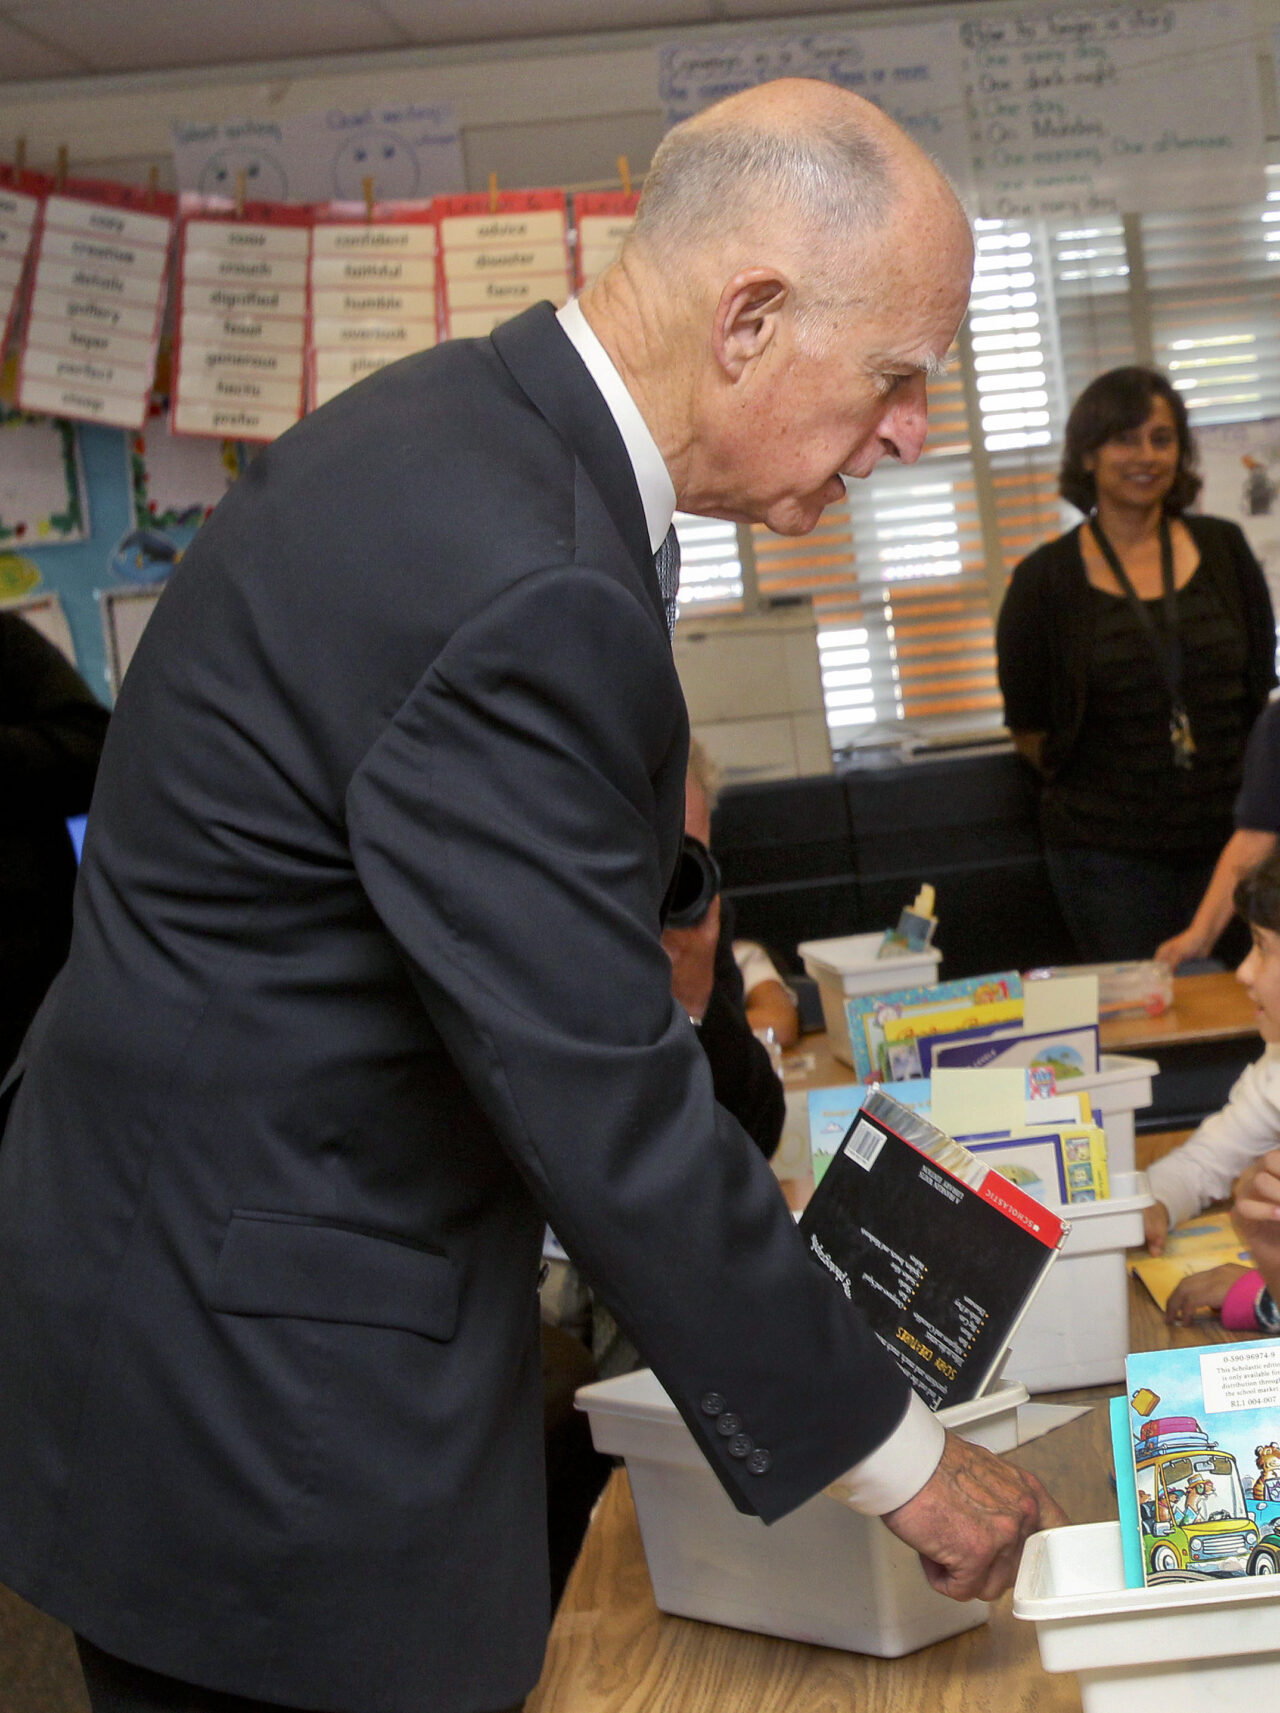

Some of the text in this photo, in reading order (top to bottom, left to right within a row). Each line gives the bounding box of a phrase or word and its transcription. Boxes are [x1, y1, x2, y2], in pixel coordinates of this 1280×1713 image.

[335, 232, 409, 249] confident
[983, 1188, 1034, 1227] SCHOLASTIC
[1223, 1352, 1276, 1363] 0-590-96974-9
[1232, 1364, 1261, 1373] Scholastic
[1229, 1373, 1242, 1381] only
[1244, 1371, 1270, 1379] available
[1222, 1381, 1258, 1390] distribution
